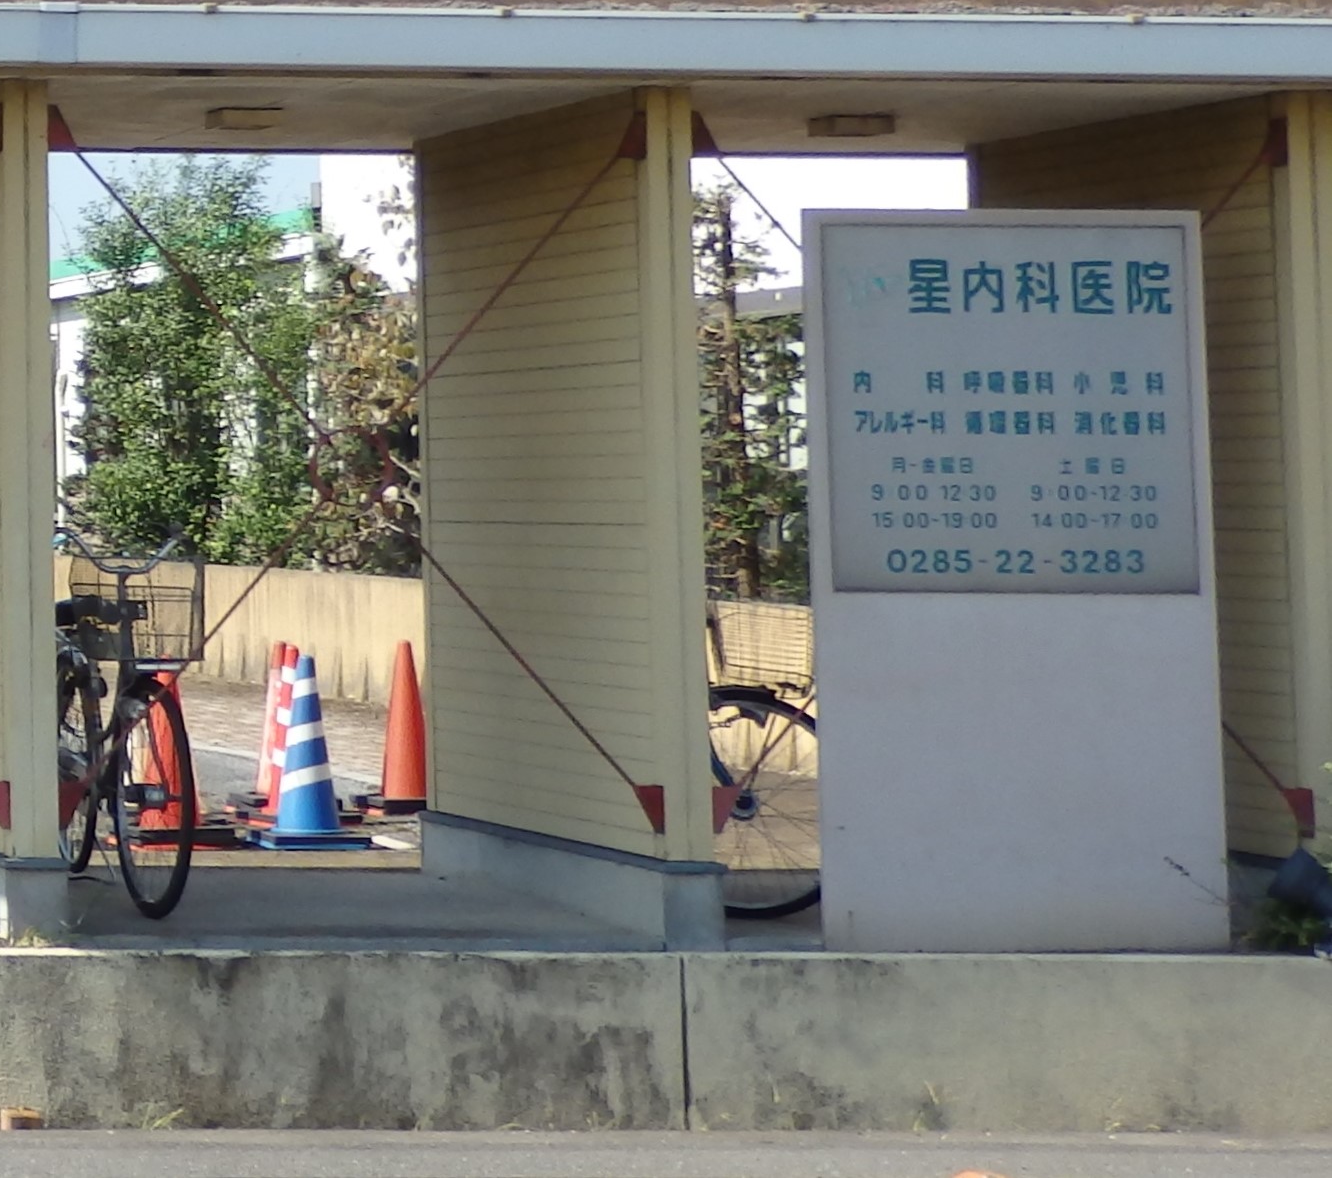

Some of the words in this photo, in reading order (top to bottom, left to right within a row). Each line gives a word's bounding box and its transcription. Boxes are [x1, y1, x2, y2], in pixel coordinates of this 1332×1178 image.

[907, 259, 1173, 315] 星内科医院
[886, 549, 1145, 574] 0285-22-3283
